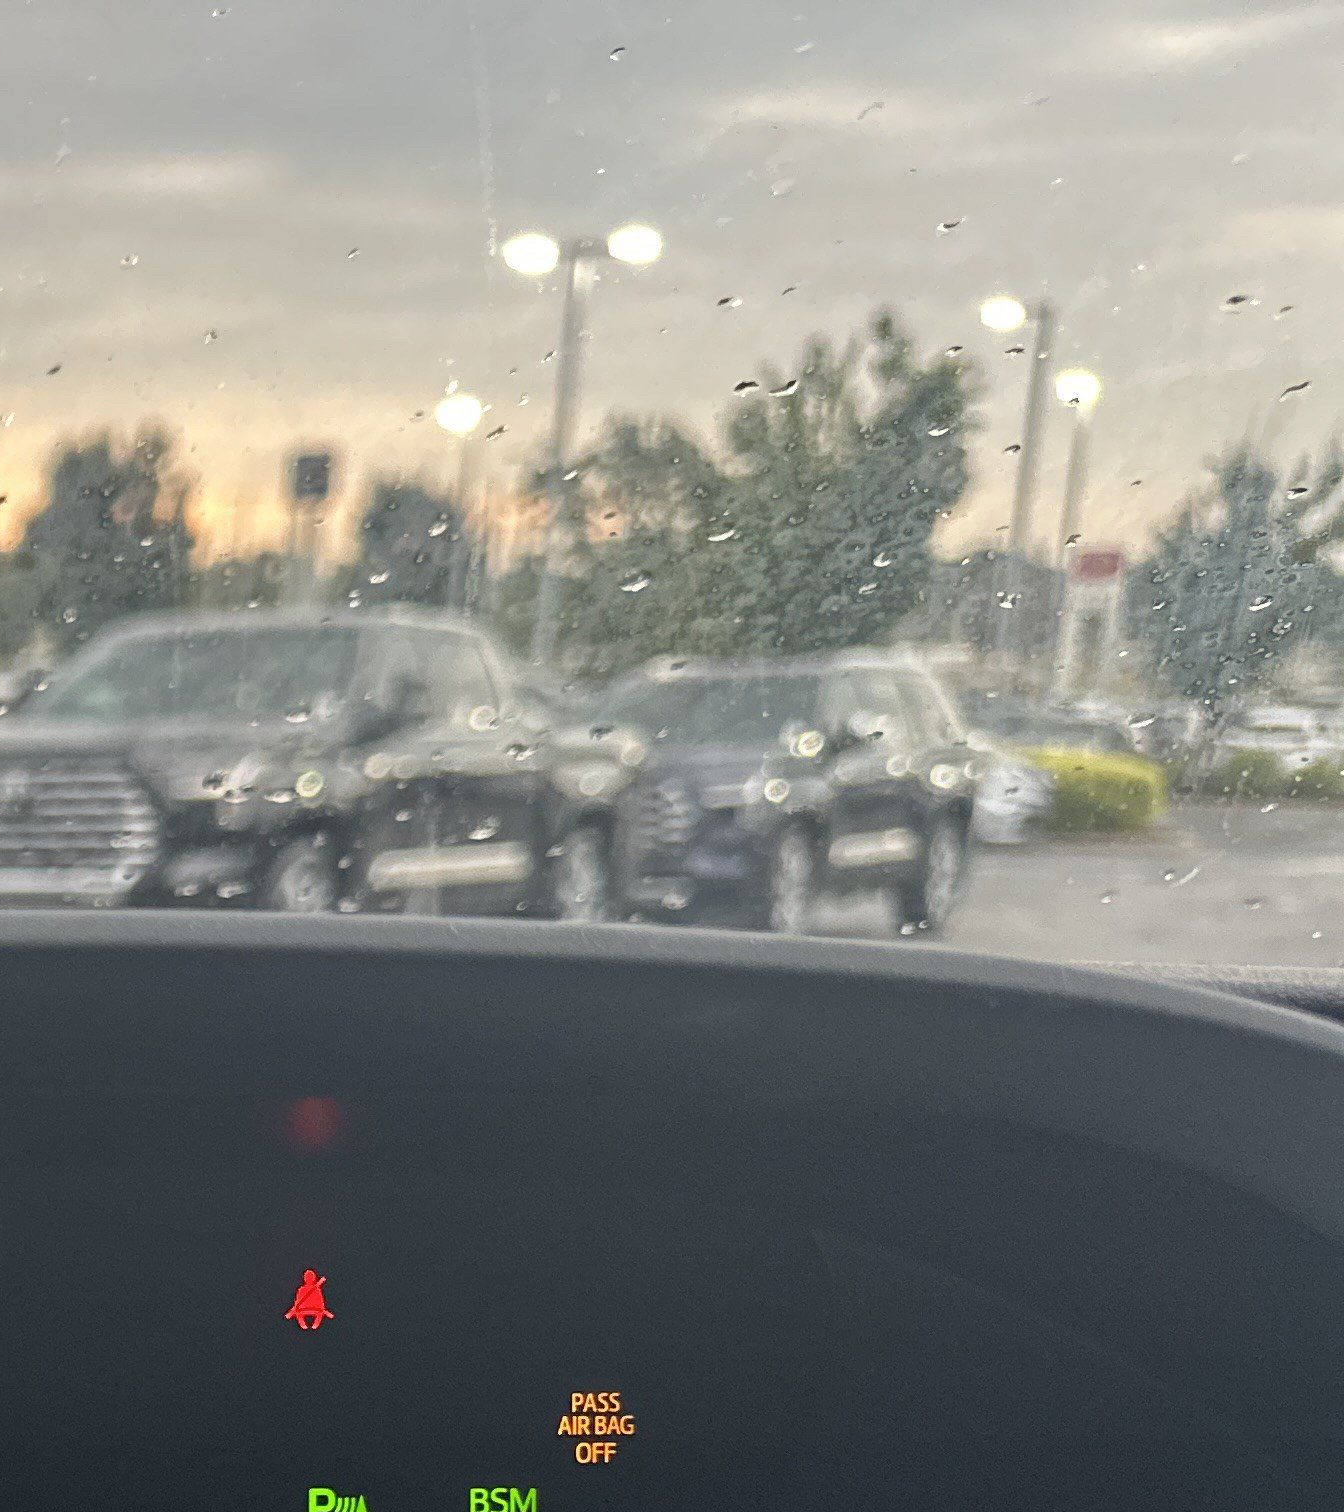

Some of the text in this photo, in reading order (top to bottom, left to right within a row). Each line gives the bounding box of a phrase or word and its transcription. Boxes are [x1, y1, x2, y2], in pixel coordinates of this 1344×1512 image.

[572, 1393, 620, 1412] PASS
[558, 1415, 634, 1435] AIR BAG
[576, 1442, 616, 1463] OFF
